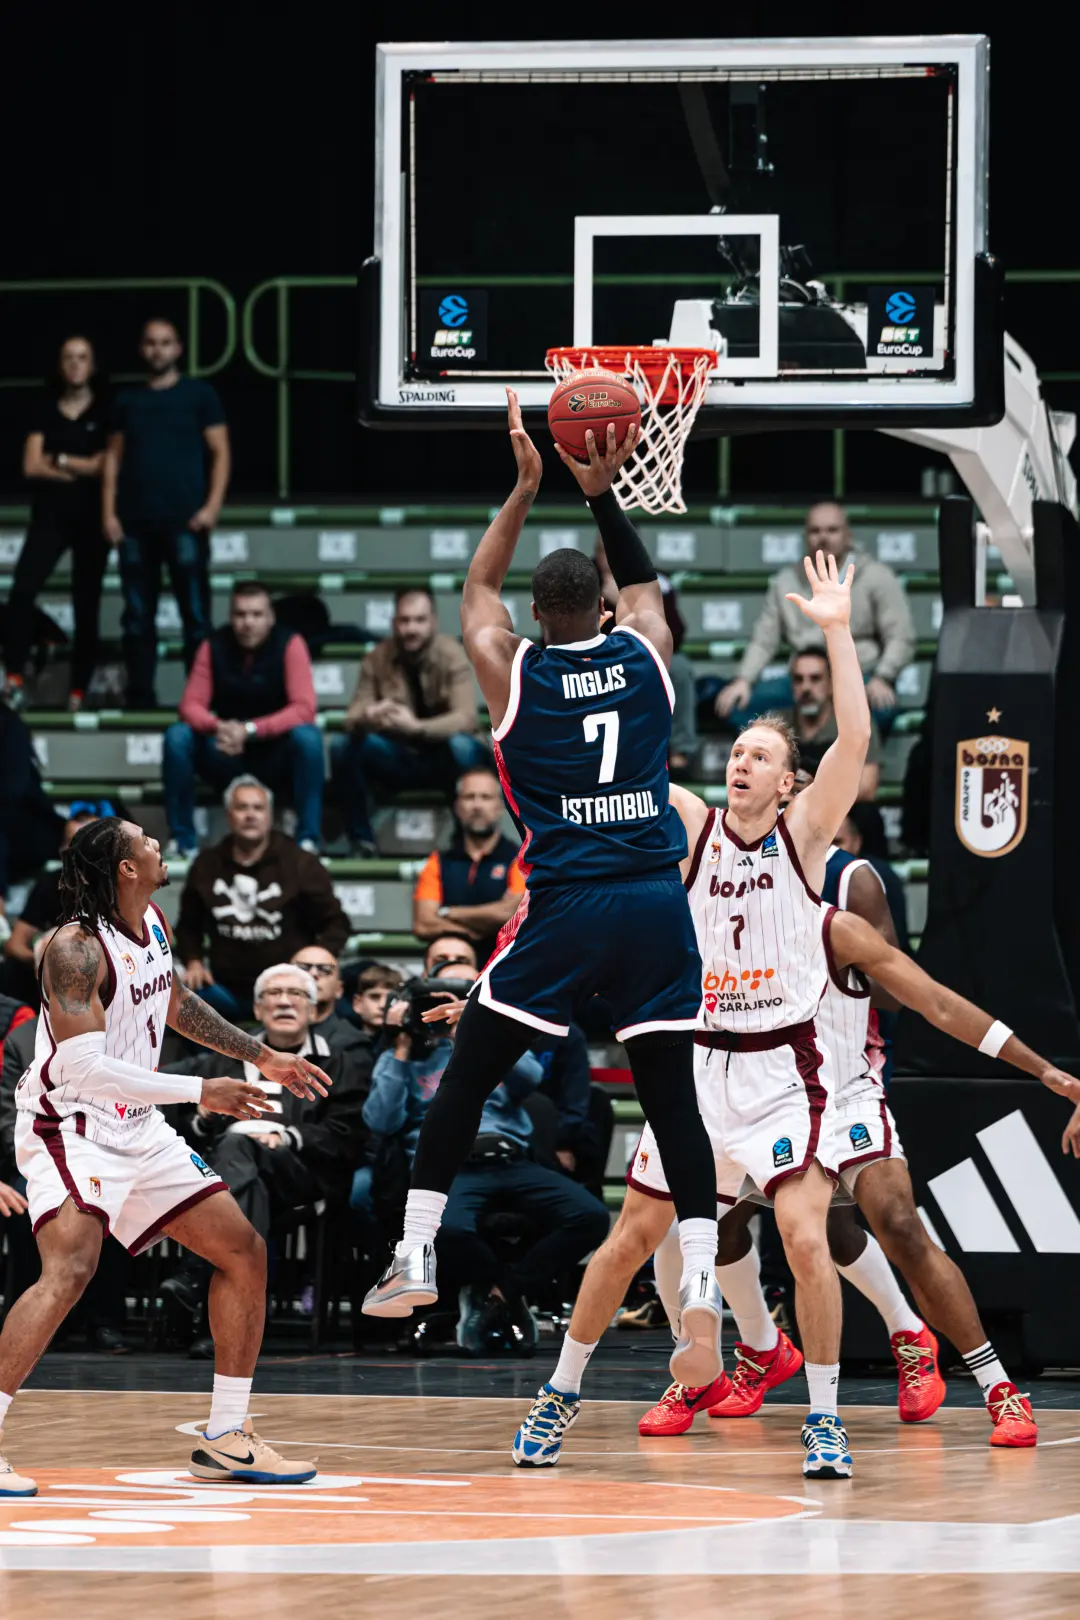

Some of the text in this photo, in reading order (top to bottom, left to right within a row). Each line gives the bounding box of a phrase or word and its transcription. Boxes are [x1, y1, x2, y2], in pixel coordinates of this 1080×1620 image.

[430, 346, 476, 359] EuroCup
[877, 343, 923, 356] EuroCup
[399, 389, 456, 404] SPALDING
[562, 664, 626, 699] INGLIS
[582, 711, 620, 784] 7
[962, 749, 1024, 766] bosna
[729, 914, 745, 950] 7
[717, 992, 746, 1001] VISIT
[719, 997, 783, 1013] SARAJEVO
